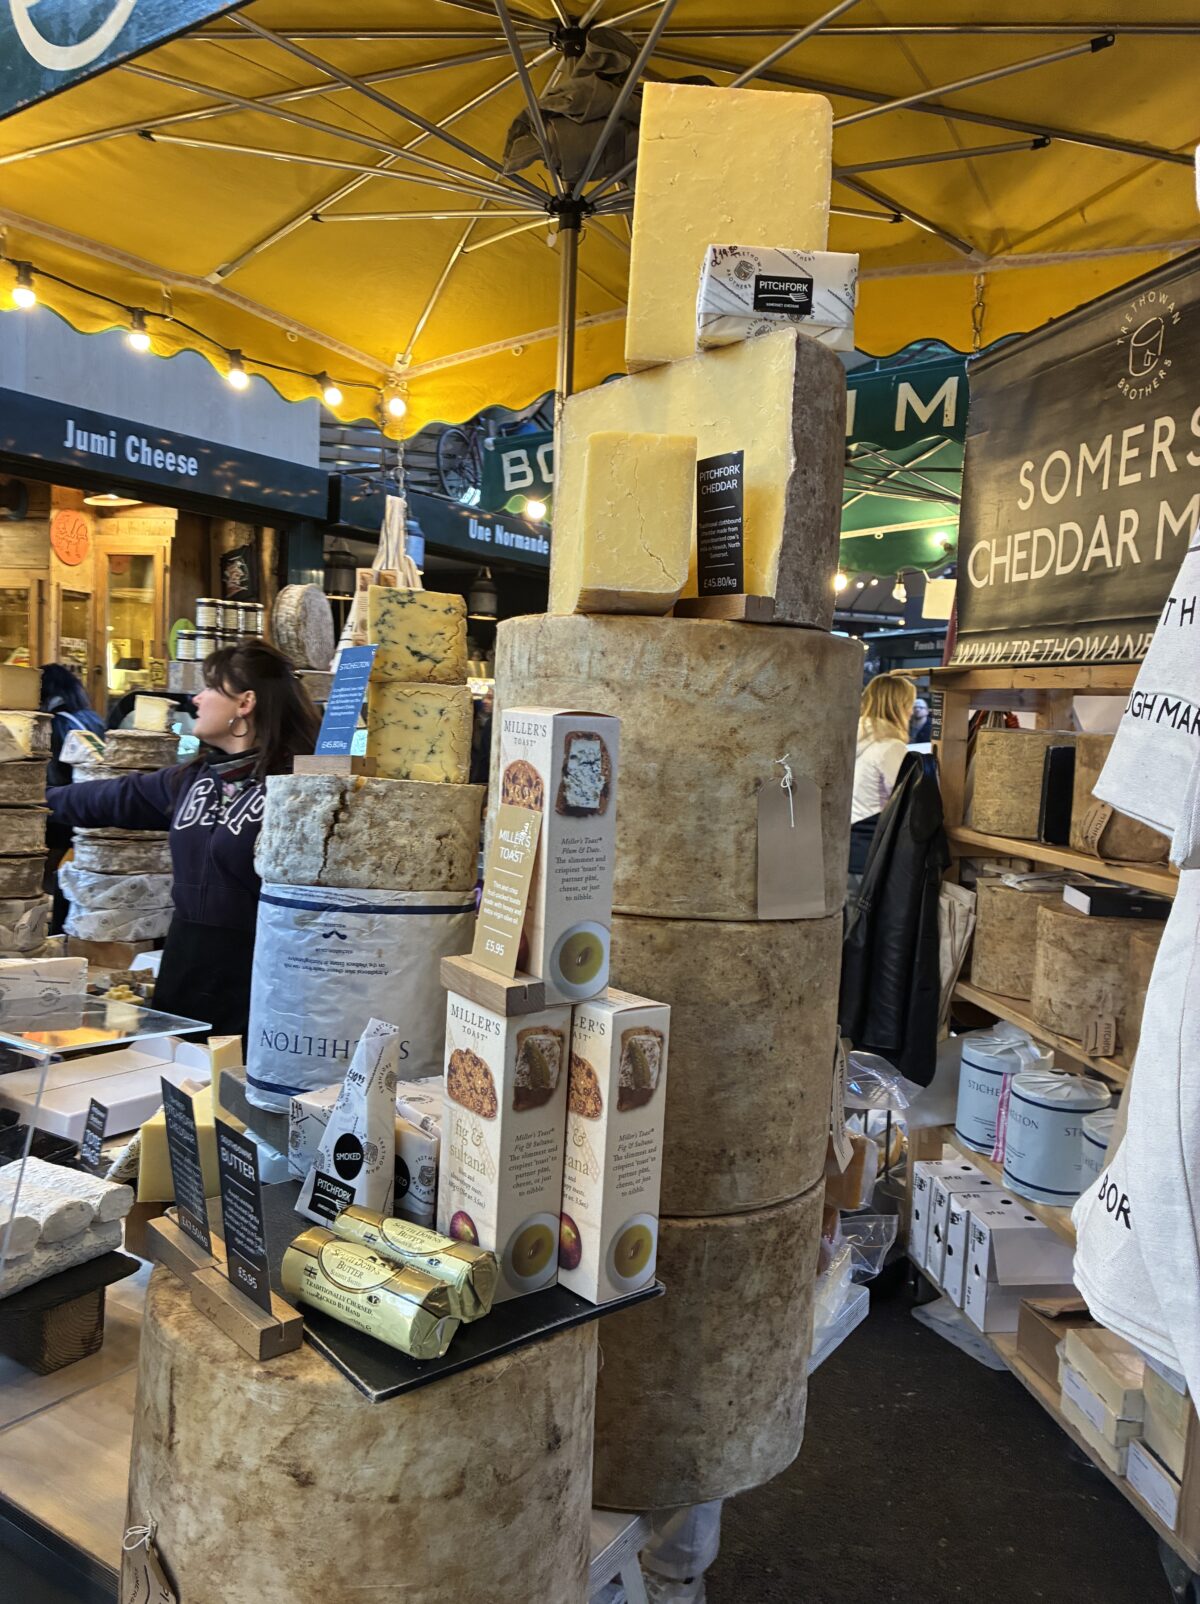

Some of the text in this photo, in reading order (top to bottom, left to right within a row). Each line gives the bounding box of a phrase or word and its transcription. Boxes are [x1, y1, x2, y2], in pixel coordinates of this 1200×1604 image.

[759, 280, 808, 292] PITCHFORK
[1117, 291, 1181, 346] TRETHOWAN
[1117, 359, 1172, 399] BROTHERS
[64, 419, 199, 476] Jumi Cheese
[699, 464, 741, 482] PITCHFORK
[701, 479, 738, 495] CHEDDAR
[468, 518, 549, 555] Une Normande
[967, 508, 1141, 589] CHEDDAR
[504, 720, 547, 738] MILLER'S
[499, 829, 530, 848] MILLER'S
[500, 847, 525, 863] TOAST
[486, 939, 505, 956] £5.95
[450, 1003, 501, 1036] MILLER'S
[260, 1028, 411, 1061] SHELTON
[455, 1118, 483, 1147] fig &
[573, 1128, 586, 1147] &
[220, 1147, 255, 1181] BUTTER
[336, 1152, 361, 1160] SMOKED
[450, 1145, 487, 1176] sultana
[317, 1178, 352, 1201] PITCHFORK
[336, 1261, 364, 1279] BUTTER
[306, 1279, 346, 1302] TRADITIONALLY
[345, 1306, 361, 1317] HAND
